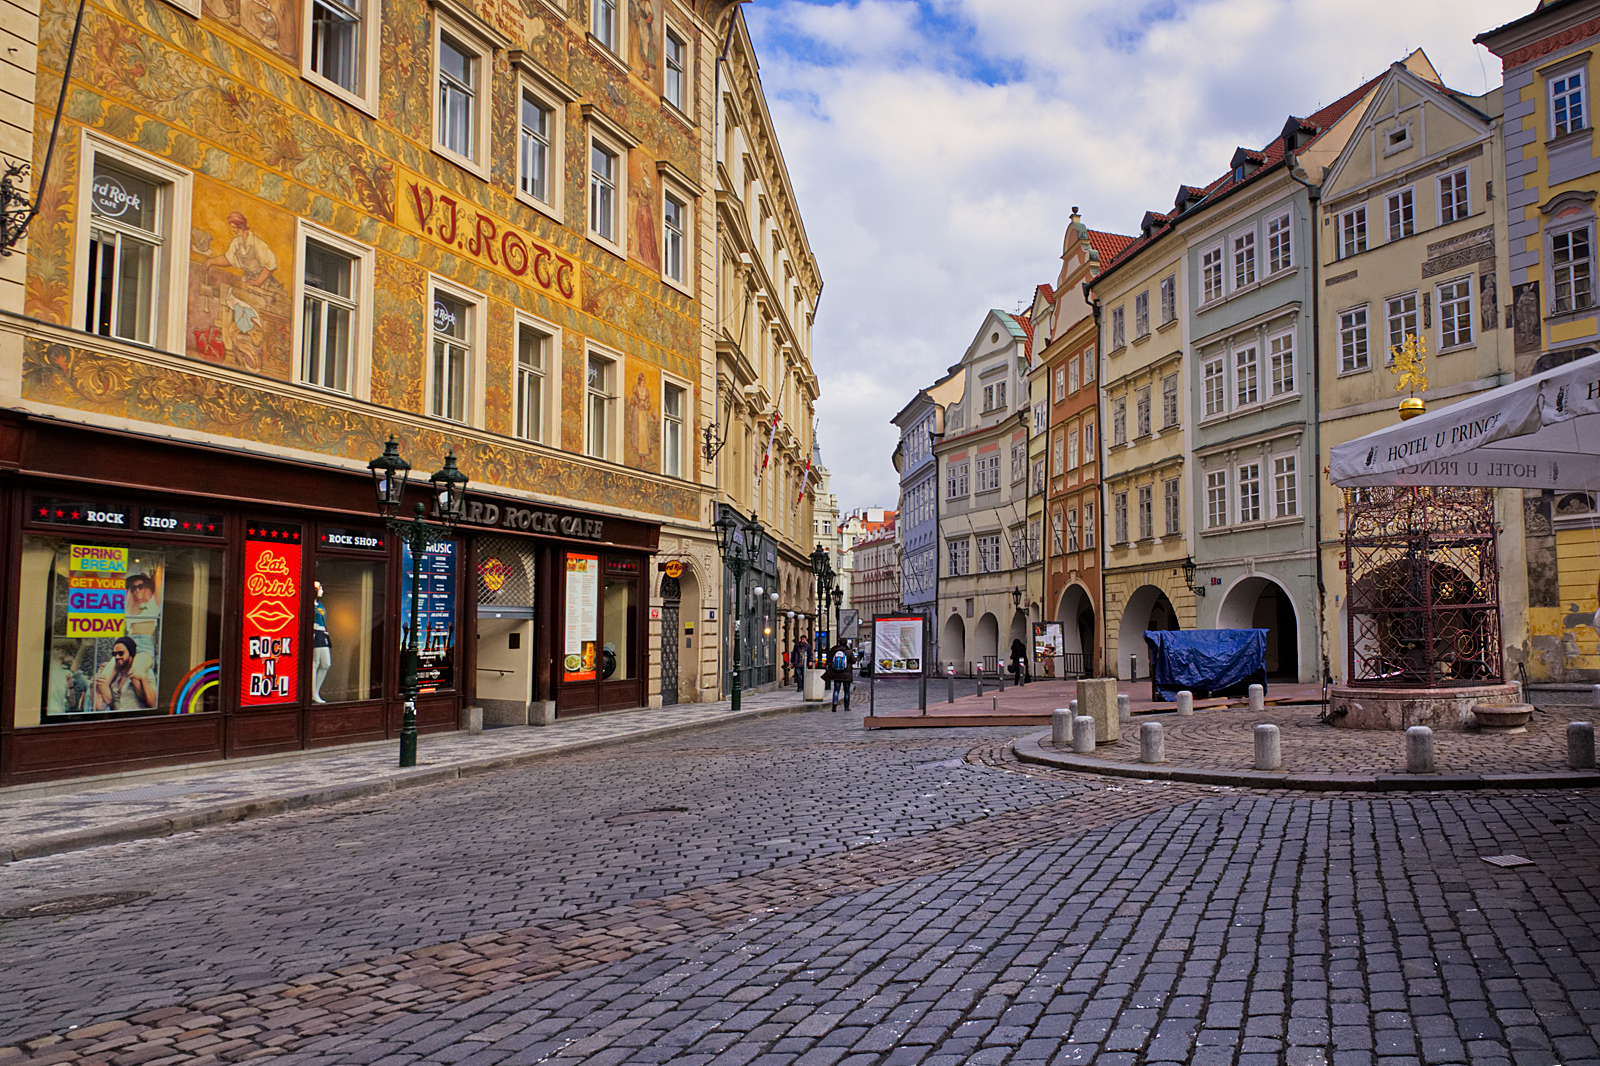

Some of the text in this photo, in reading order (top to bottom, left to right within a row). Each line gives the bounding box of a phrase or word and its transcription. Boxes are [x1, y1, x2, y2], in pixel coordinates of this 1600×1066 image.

[93, 183, 141, 210] rd Rock
[100, 198, 117, 209] CAFE
[1387, 437, 1428, 462] HOTEL
[1435, 432, 1446, 448] U
[87, 510, 178, 529] ROCK SHOP
[502, 506, 558, 533] ROCK
[561, 515, 604, 538] CAFE
[328, 534, 378, 547] ROCK SHOP
[72, 546, 122, 560] SPRING
[80, 558, 126, 572] BREAK
[70, 577, 126, 589] GET YOUR
[247, 573, 296, 597] Drink
[69, 592, 125, 610] GEAR
[69, 617, 124, 632] TODAY
[249, 636, 291, 658] ROCK
[250, 673, 289, 696] ROLL
